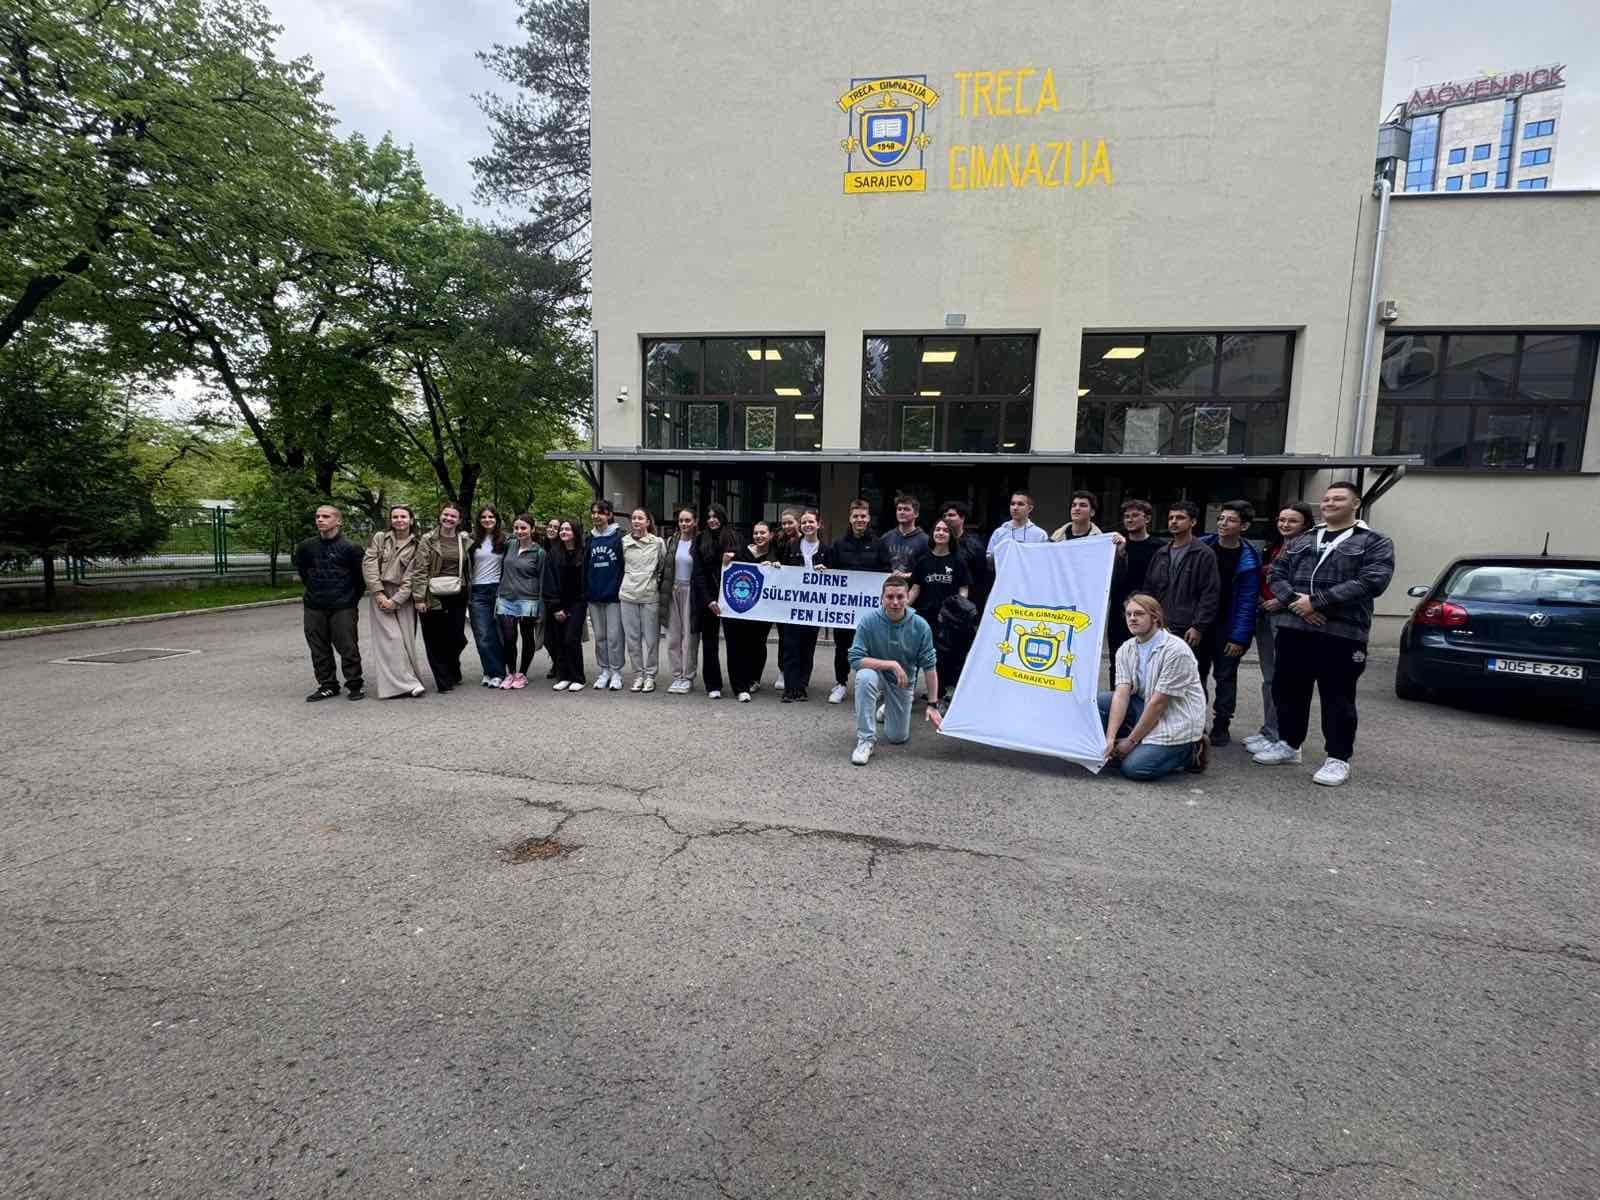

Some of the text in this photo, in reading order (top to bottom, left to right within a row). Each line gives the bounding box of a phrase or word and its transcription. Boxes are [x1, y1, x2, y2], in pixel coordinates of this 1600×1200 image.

[879, 81, 926, 98] GIMNAZIJA
[948, 137, 1113, 191] GIMNAZIJA
[853, 174, 914, 189] SARAJEVO
[802, 570, 848, 588] EDİRNE
[762, 585, 882, 608] SÜLEYMAN DEMİRE
[790, 607, 856, 625] FEN LİSESİ
[1012, 671, 1056, 686] SARAJEVO
